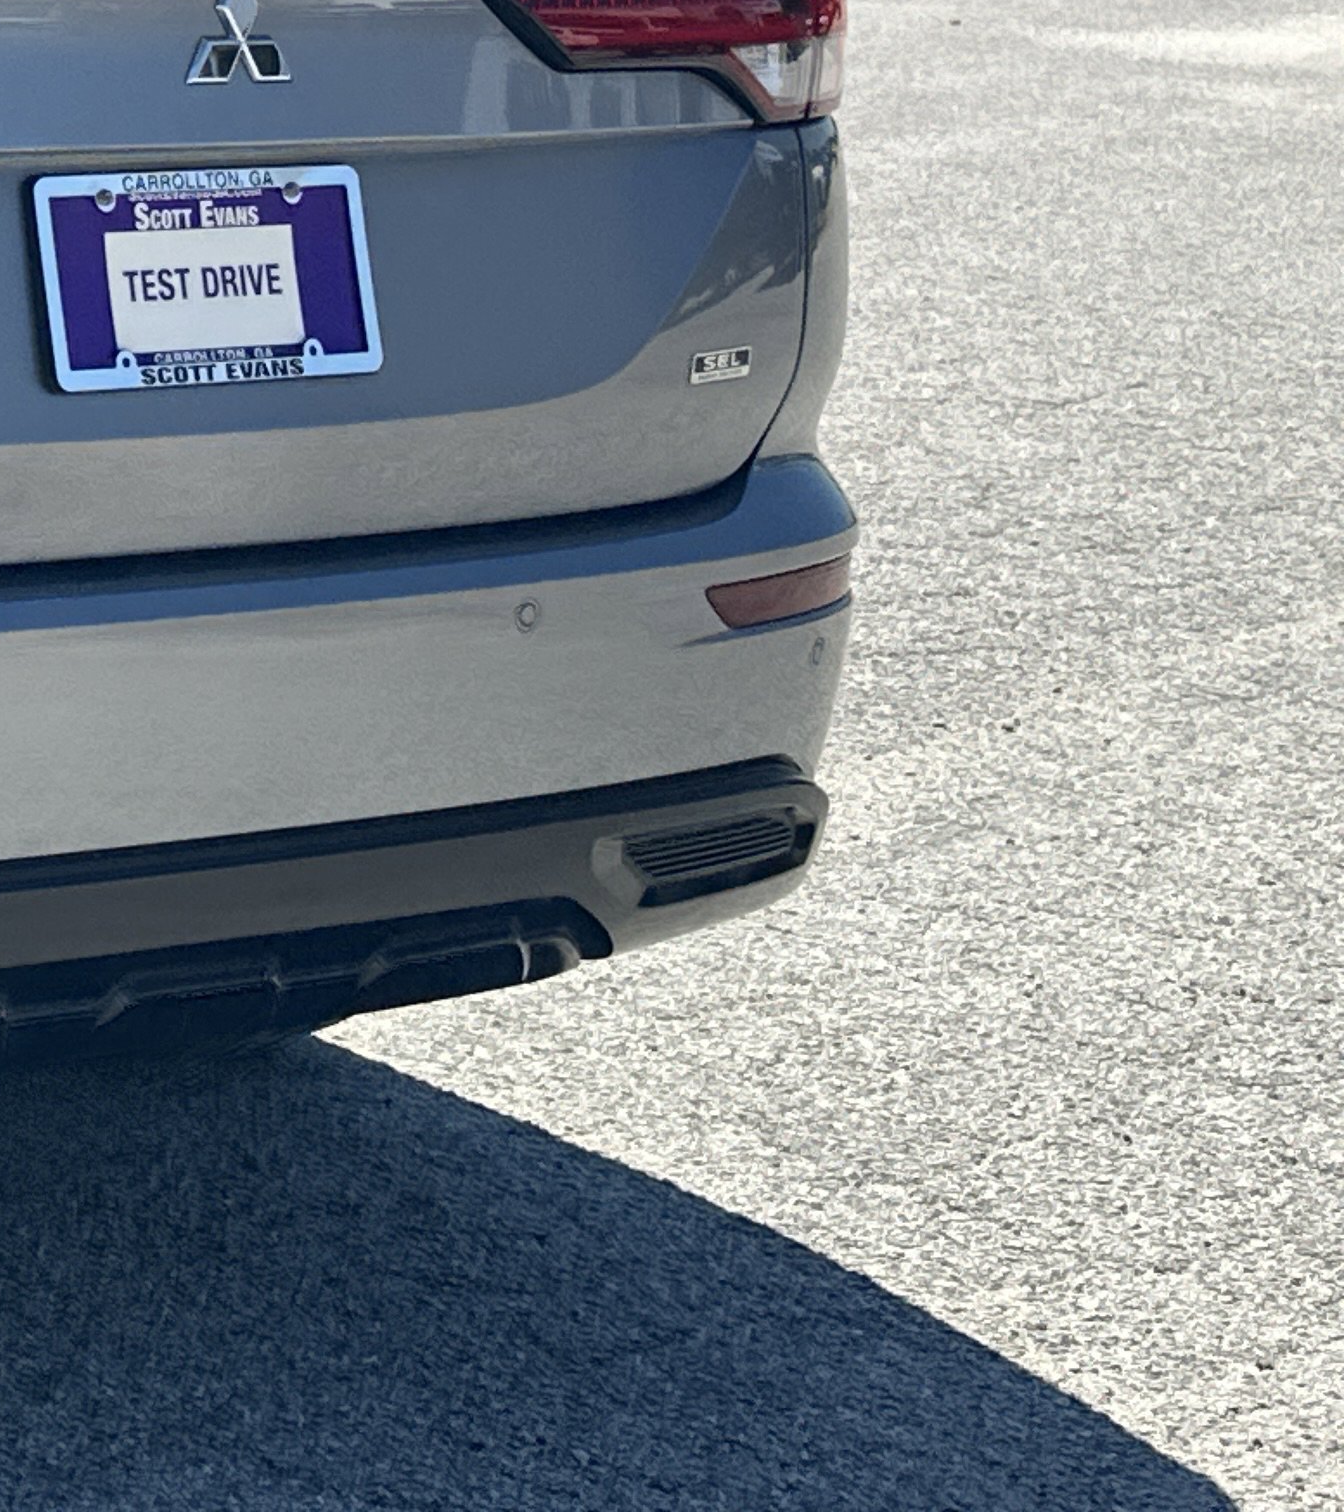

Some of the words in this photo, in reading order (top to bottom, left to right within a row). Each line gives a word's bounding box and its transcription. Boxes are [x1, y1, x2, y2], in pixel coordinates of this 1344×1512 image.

[121, 171, 244, 192] CARROLLTON,
[248, 170, 274, 187] GA
[133, 202, 192, 231] SCOTT
[199, 200, 260, 228] EVANS
[122, 267, 191, 302] TEST
[201, 263, 284, 298] DRIVE
[140, 363, 217, 385] SCOTT
[225, 358, 305, 380] EVANS
